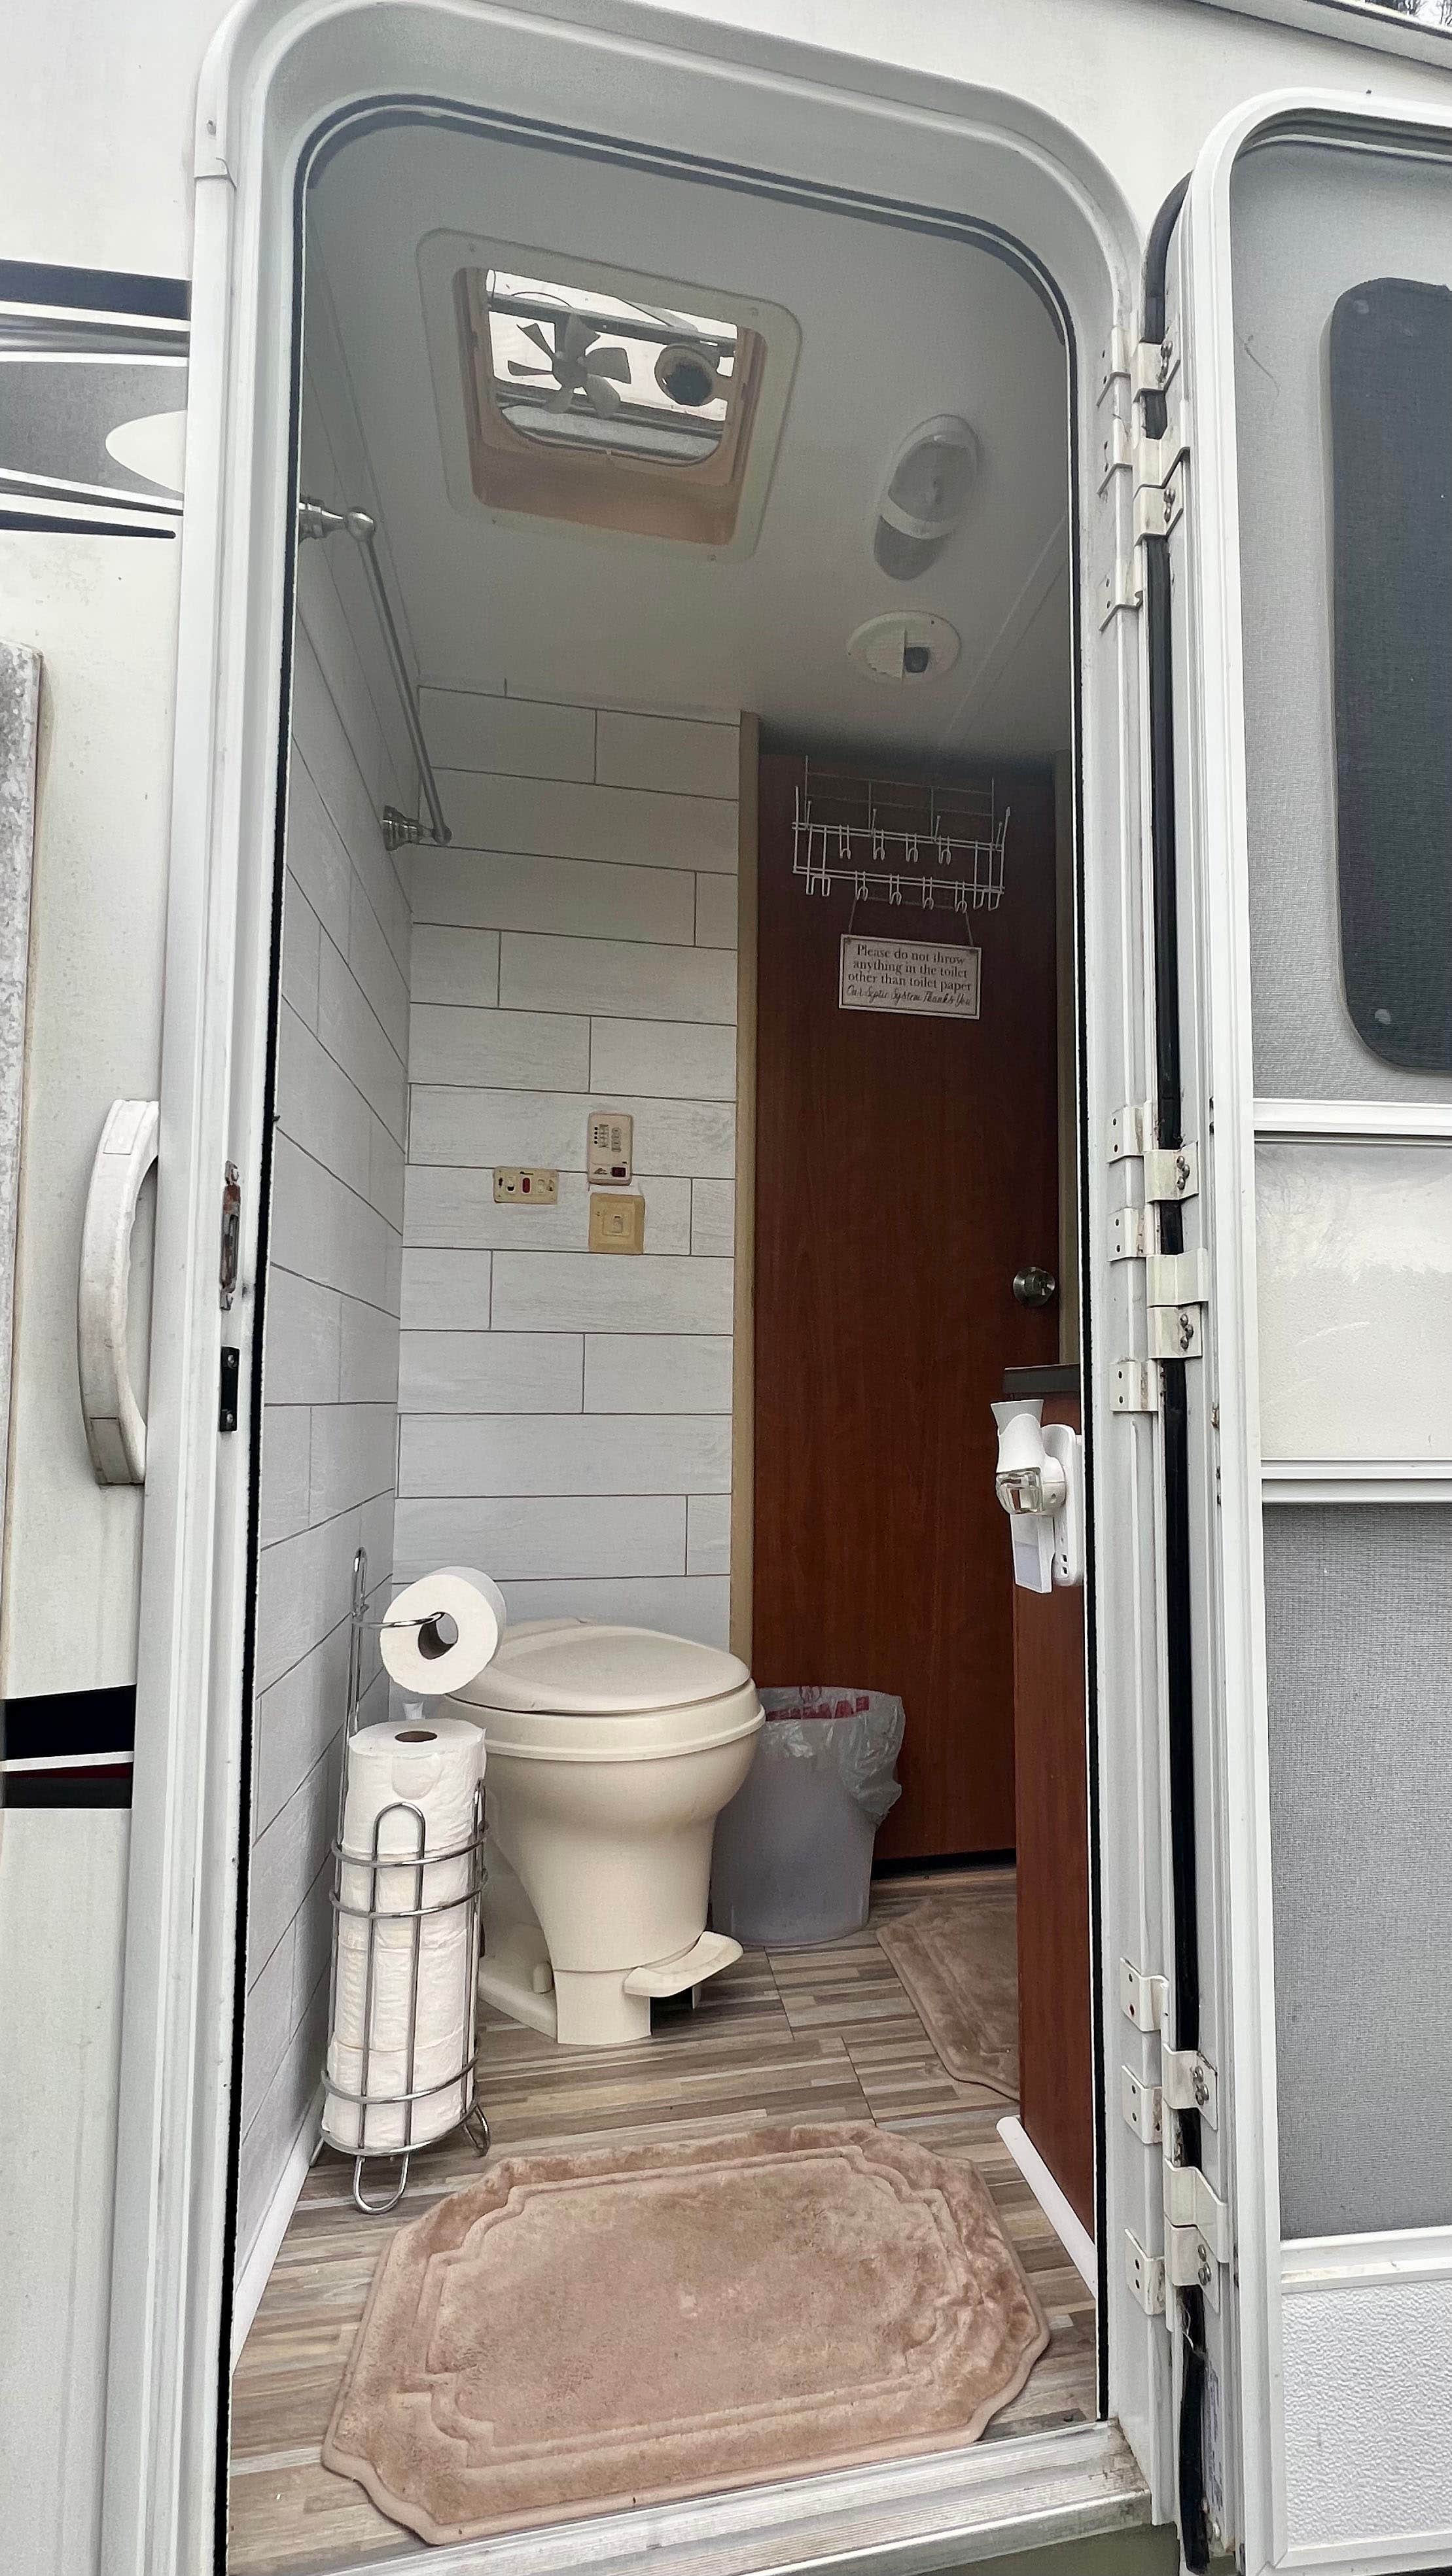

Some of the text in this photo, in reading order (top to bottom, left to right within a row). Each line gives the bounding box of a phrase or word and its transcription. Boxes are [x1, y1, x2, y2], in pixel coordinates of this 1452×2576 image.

[857, 944, 965, 964] Please do not throw
[853, 959, 967, 978] anything in the toilet
[848, 970, 971, 994] other than toilet paper
[891, 989, 920, 1006] System
[955, 993, 971, 1008] You
